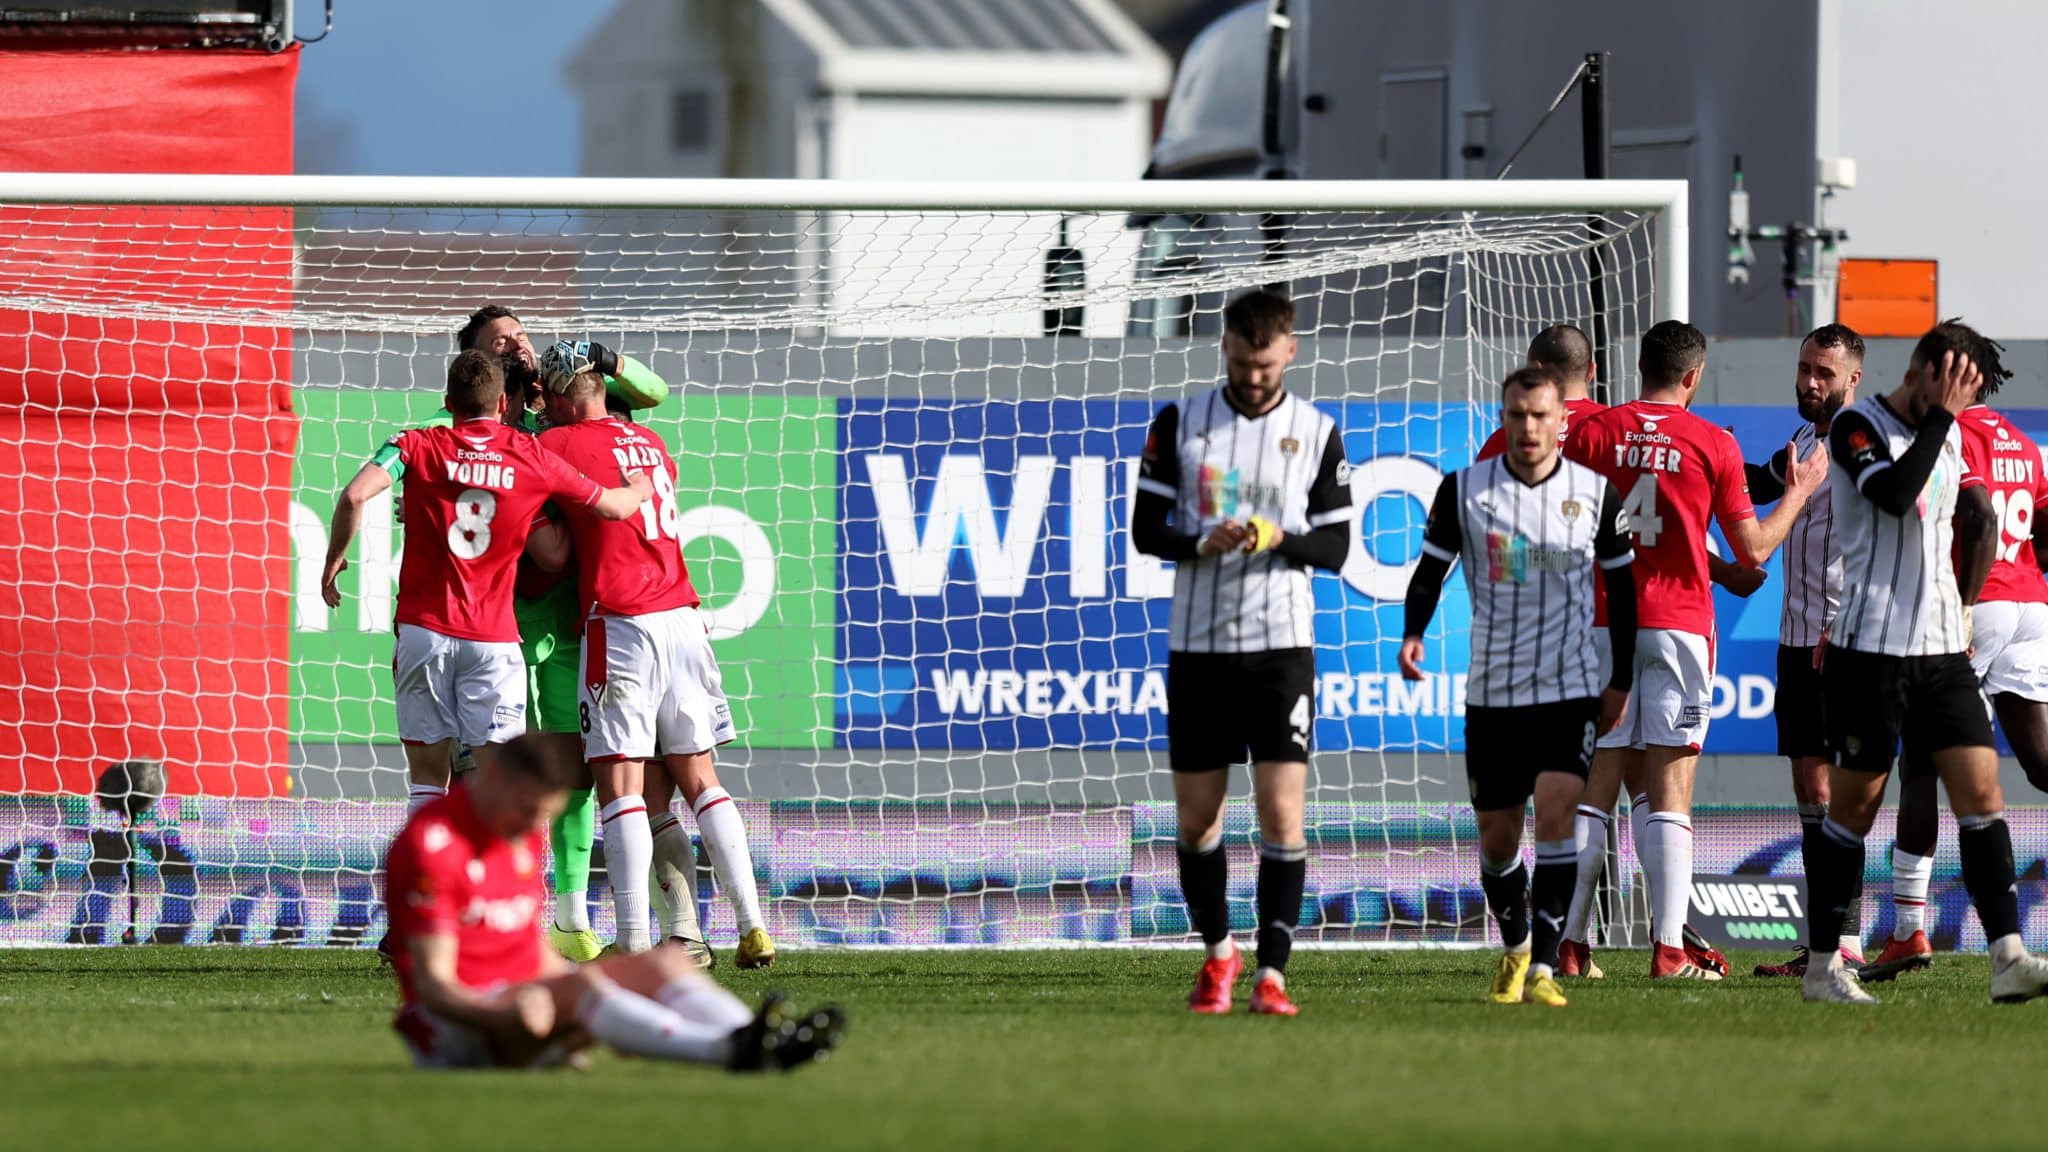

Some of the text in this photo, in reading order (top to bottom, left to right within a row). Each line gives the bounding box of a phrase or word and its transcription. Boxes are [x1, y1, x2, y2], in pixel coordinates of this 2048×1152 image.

[457, 449, 503, 463] Expedia
[1625, 431, 1672, 445] Expedia
[446, 460, 515, 489] YOUNG
[1615, 444, 1682, 473] TOZER
[626, 464, 679, 540] 18
[1622, 472, 1663, 547] 4
[447, 488, 497, 560] 8
[866, 455, 1461, 602] WILO
[930, 668, 1169, 716] WREXHA
[1313, 671, 1467, 717] REMIE
[1290, 694, 1311, 734] 4
[1690, 882, 1804, 918] UNIBET
